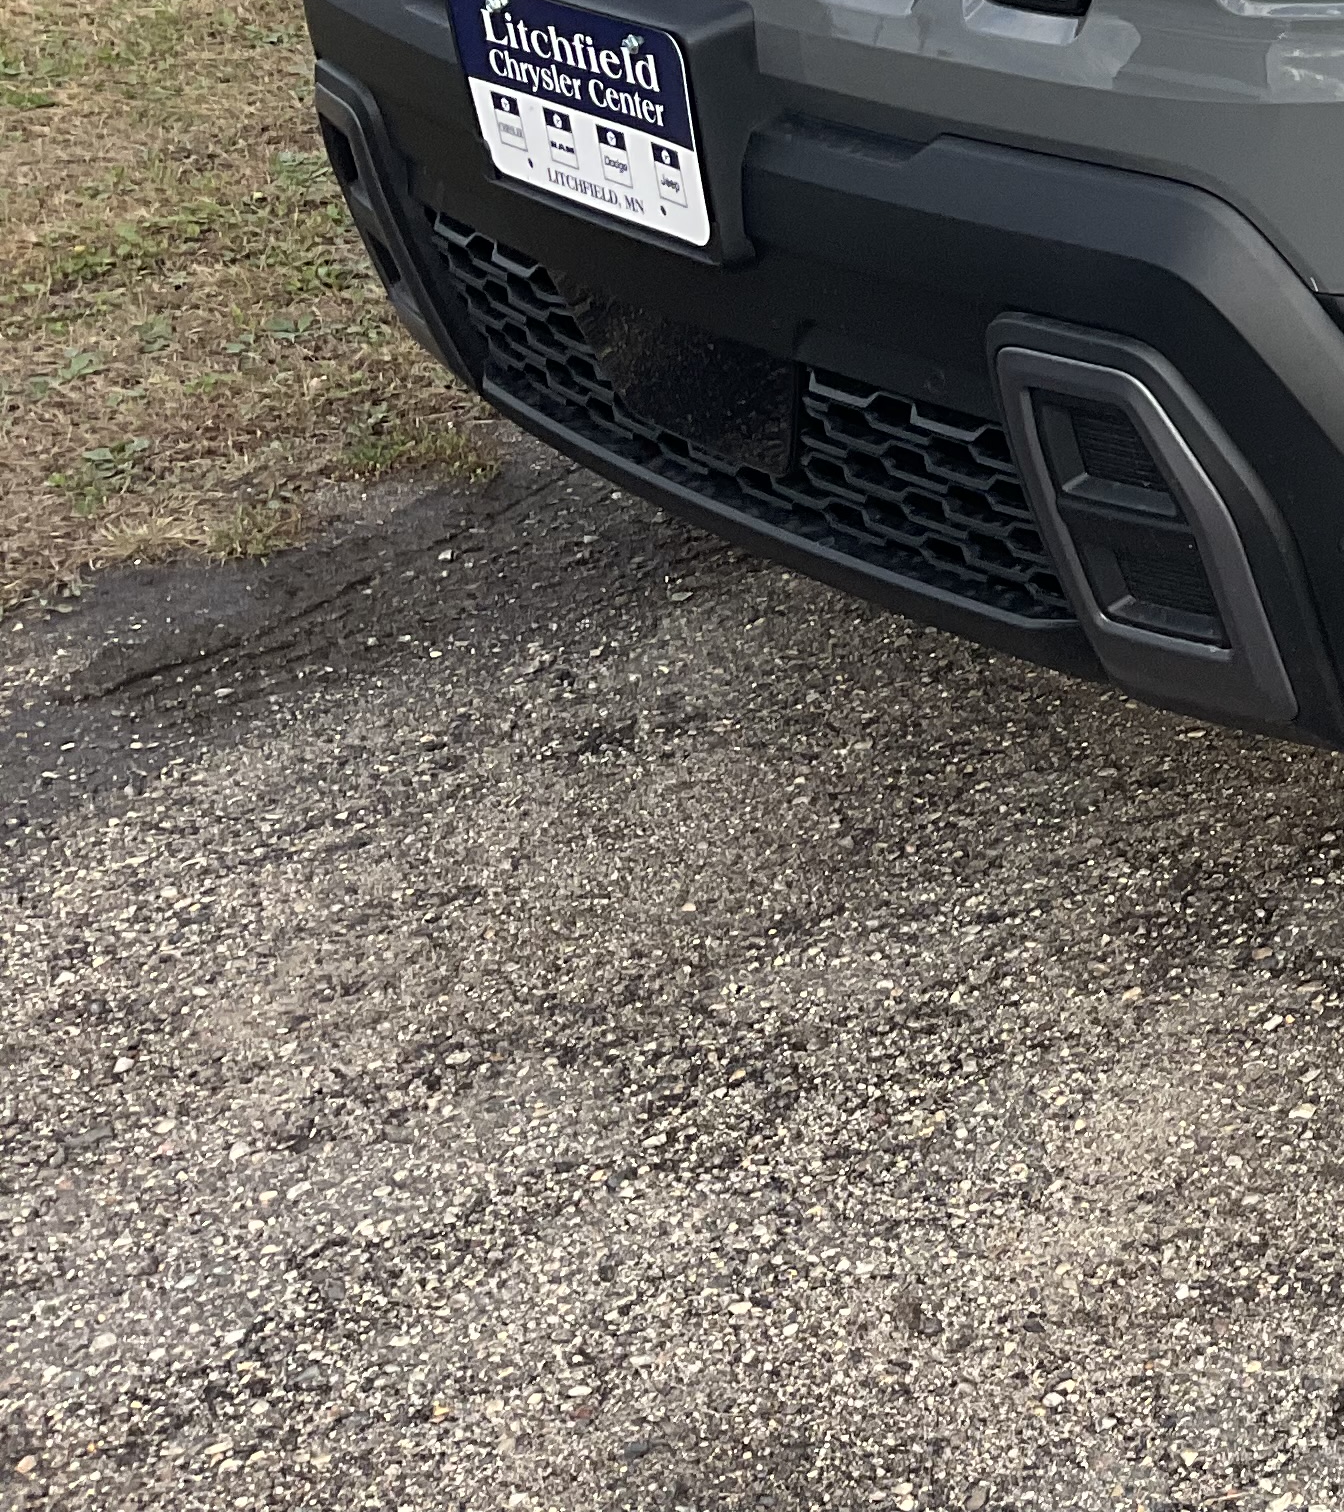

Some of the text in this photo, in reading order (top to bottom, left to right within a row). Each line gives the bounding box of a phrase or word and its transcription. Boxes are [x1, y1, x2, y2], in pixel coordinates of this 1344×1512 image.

[480, 8, 660, 93] Litchfield
[489, 48, 664, 127] Chrysler Center
[604, 155, 628, 173] Dodge
[661, 174, 680, 193] Jeep
[547, 167, 646, 215] LITCHFIELD, MN
